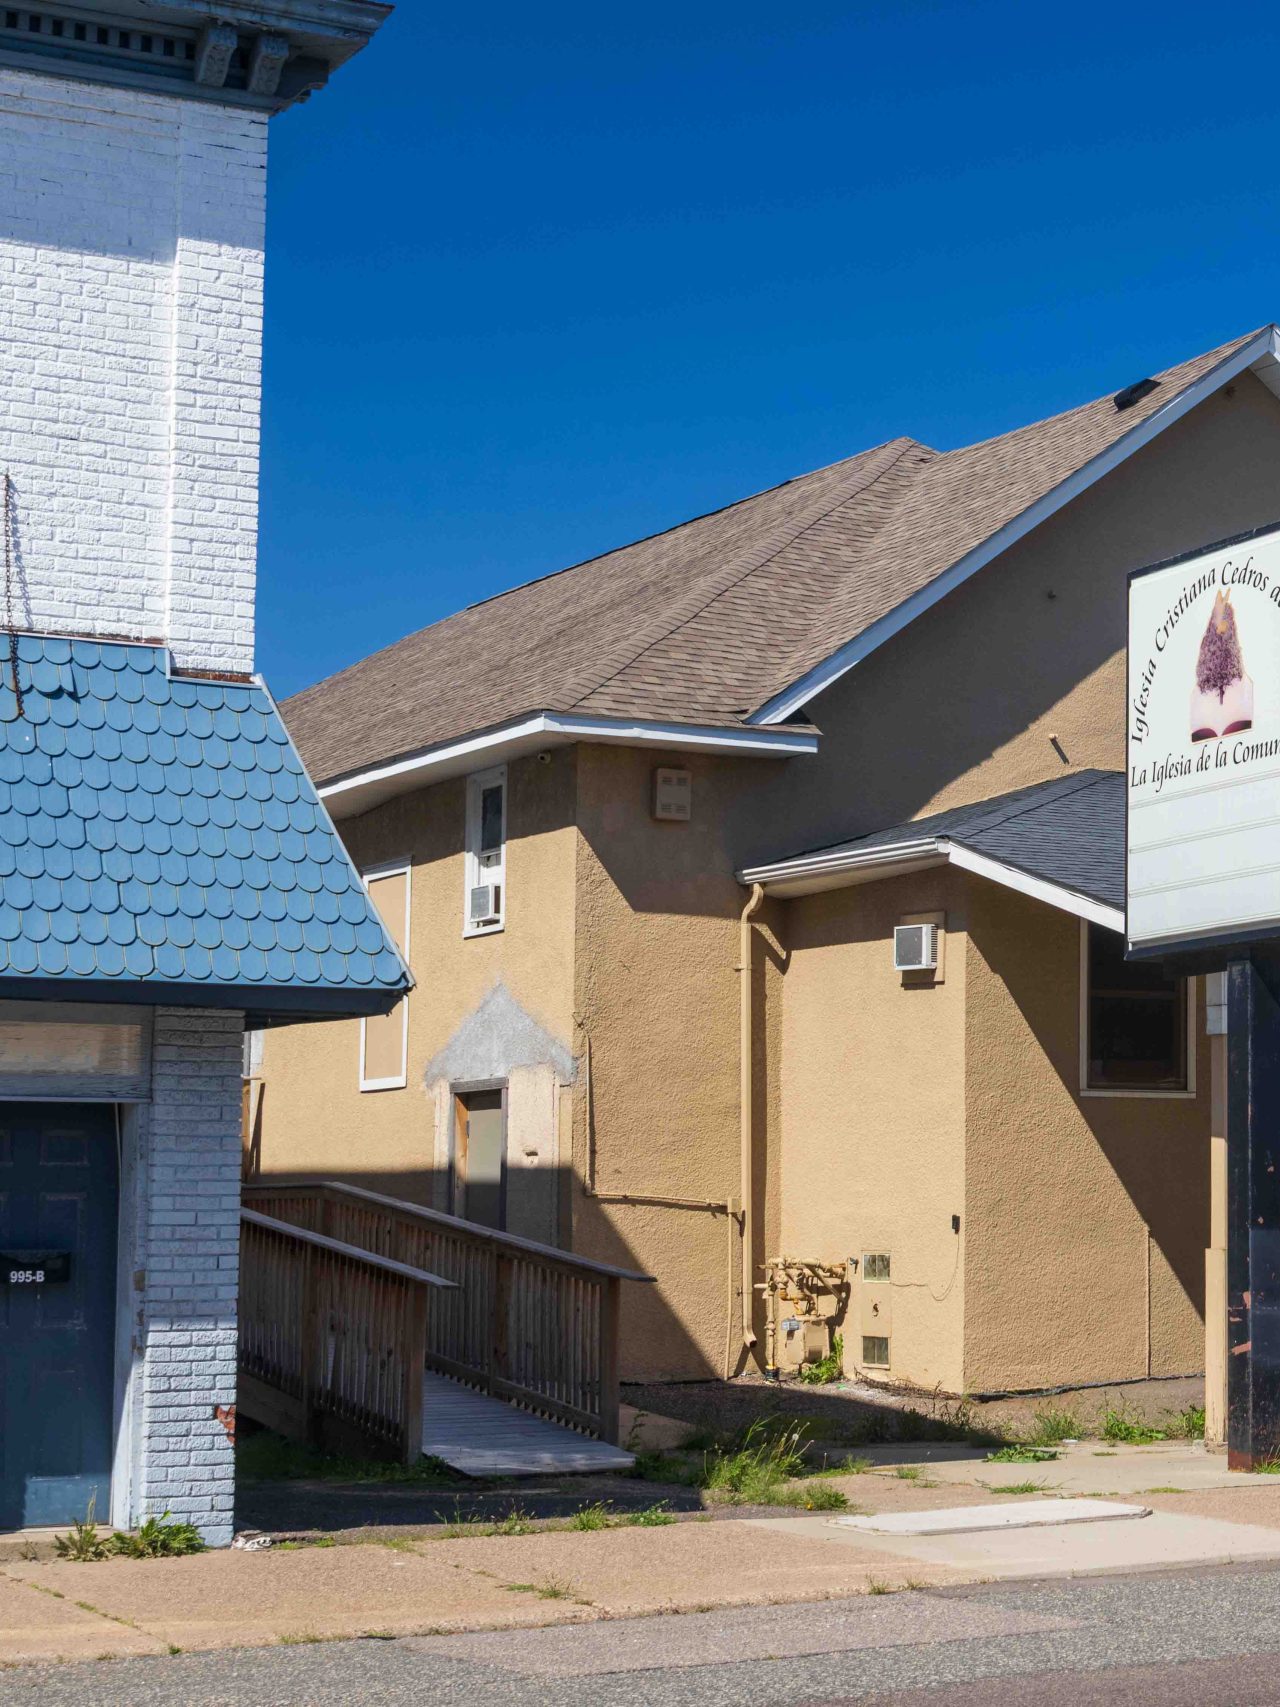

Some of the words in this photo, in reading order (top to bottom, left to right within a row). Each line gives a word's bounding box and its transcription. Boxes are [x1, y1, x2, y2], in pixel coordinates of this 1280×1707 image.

[1131, 658, 1157, 745] Iglesia
[1155, 567, 1216, 652] Cristiana
[1221, 556, 1270, 592] Cedros
[1130, 766, 1147, 787] La
[1151, 753, 1192, 793] Iglesia
[1196, 744, 1211, 773] de
[1215, 741, 1227, 769] la
[10, 1270, 45, 1283] 995-B
